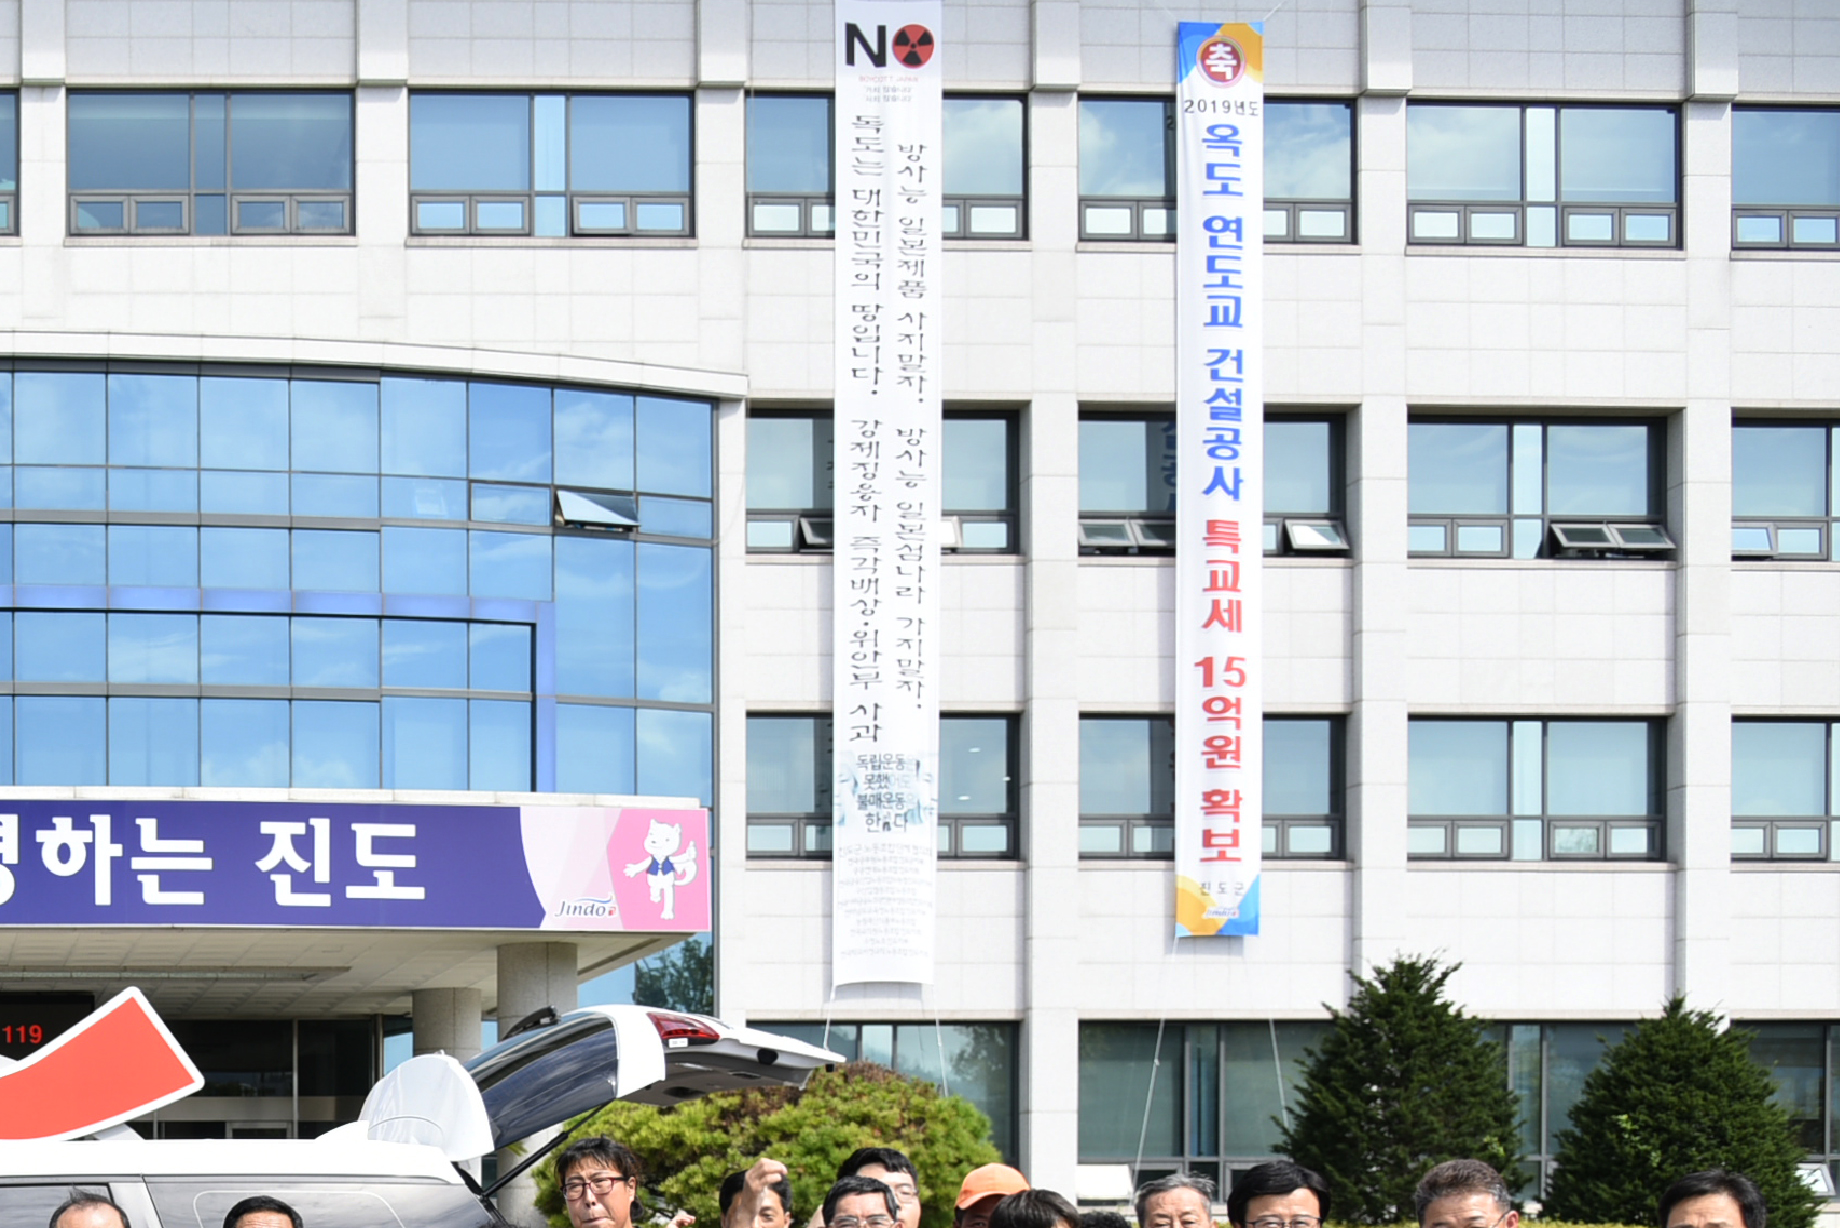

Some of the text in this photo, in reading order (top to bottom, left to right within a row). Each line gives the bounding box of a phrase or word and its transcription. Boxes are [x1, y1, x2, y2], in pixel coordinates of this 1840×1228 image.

[1205, 43, 1238, 80] 축
[1183, 99, 1259, 116] 2019년도
[851, 115, 884, 176] 독도는
[851, 188, 884, 290] 대한민국의
[851, 303, 884, 395] 땅입니다.
[895, 144, 927, 709] 방사능 일본제품 사지말자. 방사능 일본섬나라 가지말자.
[850, 419, 883, 523] 강제징용자
[1194, 123, 1246, 863] 옥도 연도교 건설공사 특교세 15억원 확보
[849, 702, 882, 743] 사과
[254, 818, 427, 907] 진도
[554, 900, 607, 917] Jindo
[3, 1025, 42, 1044] 119
